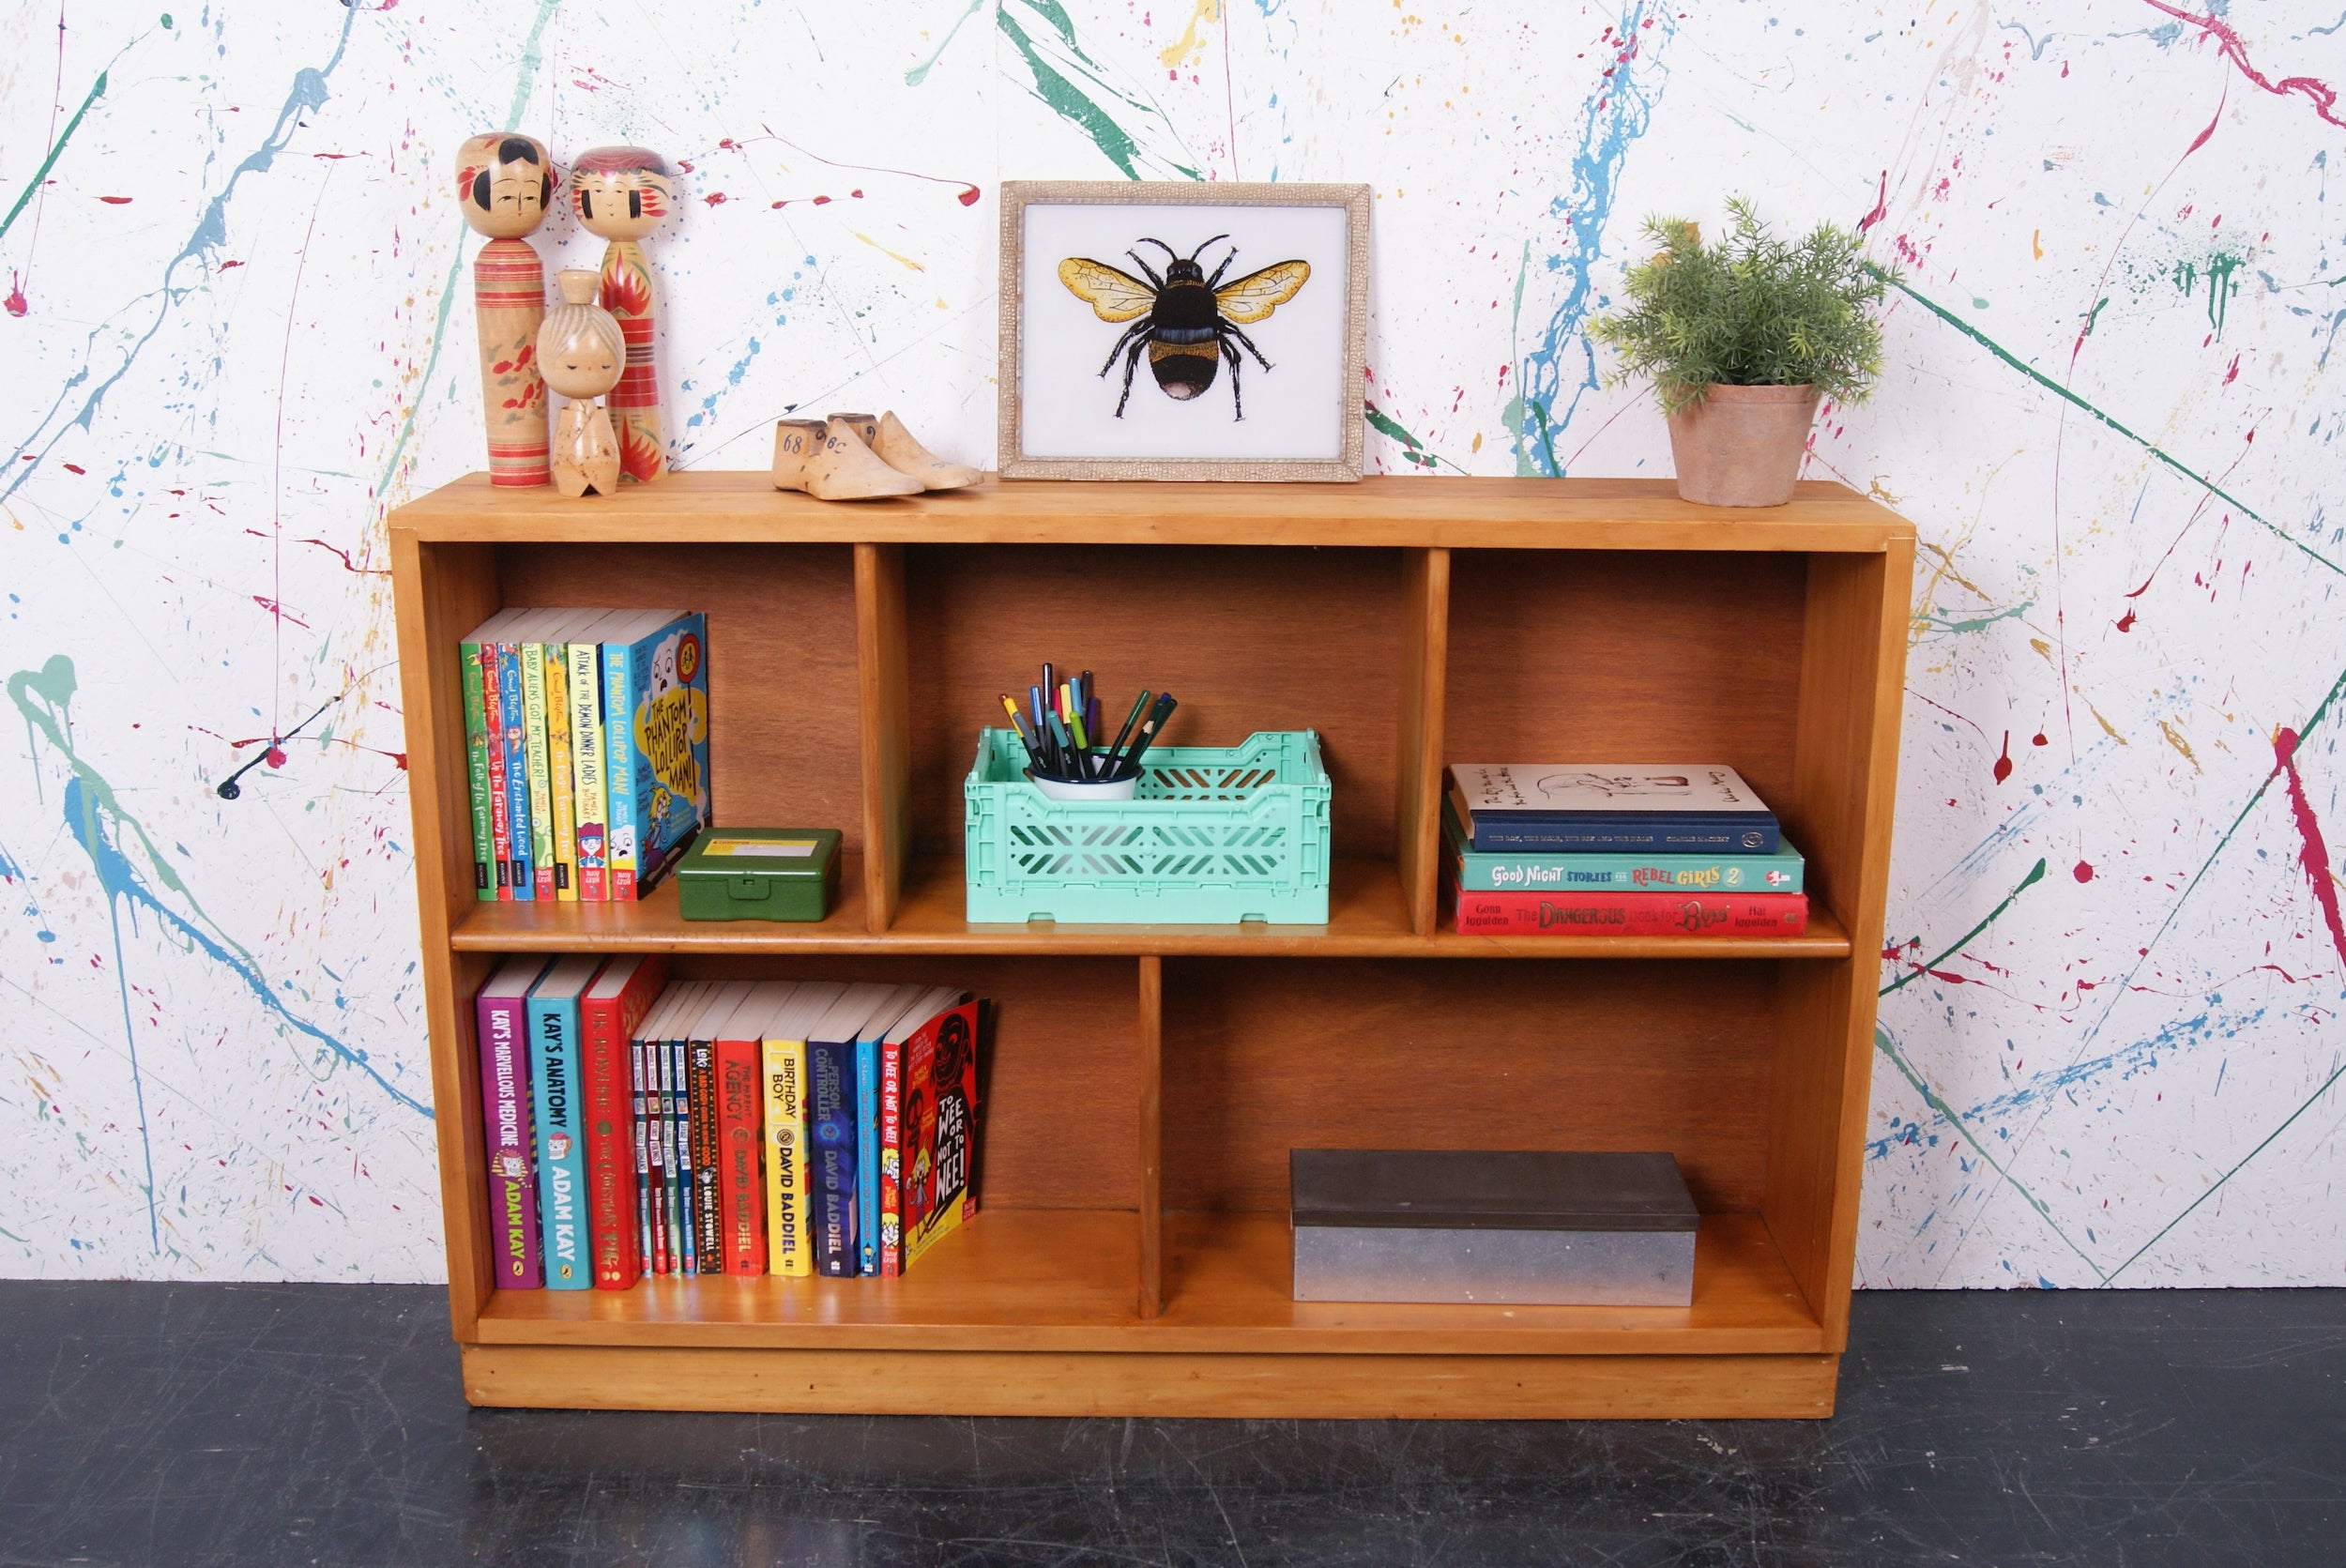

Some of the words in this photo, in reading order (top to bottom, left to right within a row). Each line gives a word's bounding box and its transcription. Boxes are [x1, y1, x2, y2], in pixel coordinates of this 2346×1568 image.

[784, 434, 801, 454] 68
[526, 649, 539, 672] BABY
[576, 650, 590, 676] ATTACK
[609, 653, 623, 668] THE
[527, 673, 541, 701] ALIENS
[580, 690, 590, 700] THE
[609, 671, 627, 717] PHANTOM
[529, 703, 541, 721] GOT
[578, 704, 592, 728] DEMON
[652, 698, 664, 721] THE
[530, 725, 541, 737] MY
[644, 695, 687, 756] PHANTOM
[580, 732, 596, 757] DINNER
[612, 720, 628, 764] LOLLIPOP
[655, 723, 687, 775] LOLLIPOP
[474, 763, 484, 782] Folk
[511, 762, 522, 777] The
[531, 740, 544, 778] TEACHER!
[581, 759, 597, 784] LADIES
[668, 755, 693, 793] MAN!
[472, 783, 484, 793] of
[612, 765, 631, 795] MAN!
[493, 791, 505, 834] Faraway
[511, 780, 526, 829] Enchanted
[476, 806, 487, 840] Faraway
[479, 843, 487, 860] Tree
[496, 835, 506, 856] Tree
[516, 830, 527, 857] Wood
[1567, 871, 1612, 882] STORIES
[1632, 868, 1674, 887] REBEL
[1727, 867, 1739, 885] 2
[492, 1010, 510, 1039] KAY'S
[543, 1013, 563, 1054] KAY'S
[495, 1042, 515, 1098] MARVELLOUS
[594, 1038, 610, 1114] ROWLING
[698, 1075, 708, 1088] BAD
[815, 1048, 831, 1121] CONTROLLER
[885, 1061, 898, 1079] WEE
[545, 1058, 567, 1127] ANATOMY
[724, 1059, 742, 1120] AGENCY
[772, 1073, 784, 1102] BOY
[784, 1058, 797, 1119] BIRTHDAY
[829, 1065, 841, 1109] PERSON
[885, 1080, 898, 1093] OR
[885, 1095, 898, 1113] NOT
[938, 1095, 953, 1113] TO
[498, 1100, 518, 1146] MEDICINE
[885, 1126, 898, 1144] WEE!
[938, 1098, 964, 1146] WEE
[949, 1118, 963, 1136] OR
[702, 1146, 710, 1165] GOOD
[937, 1140, 952, 1163] NOT
[954, 1134, 965, 1151] TO
[735, 1149, 749, 1189] DAVID
[780, 1147, 794, 1188] DAVID
[825, 1149, 838, 1190] DAVID
[936, 1148, 965, 1208] WEE!
[505, 1180, 523, 1225] ADAM
[552, 1166, 572, 1220] ADAM
[704, 1186, 712, 1210] LOUIE
[705, 1212, 714, 1251] STOWELL
[736, 1193, 752, 1253] BADDIEL
[781, 1193, 796, 1255] BADDIEL
[826, 1194, 842, 1255] BADDIEL
[509, 1229, 526, 1259] KAY
[556, 1224, 575, 1261] KAY
[601, 1230, 619, 1269] PIG
